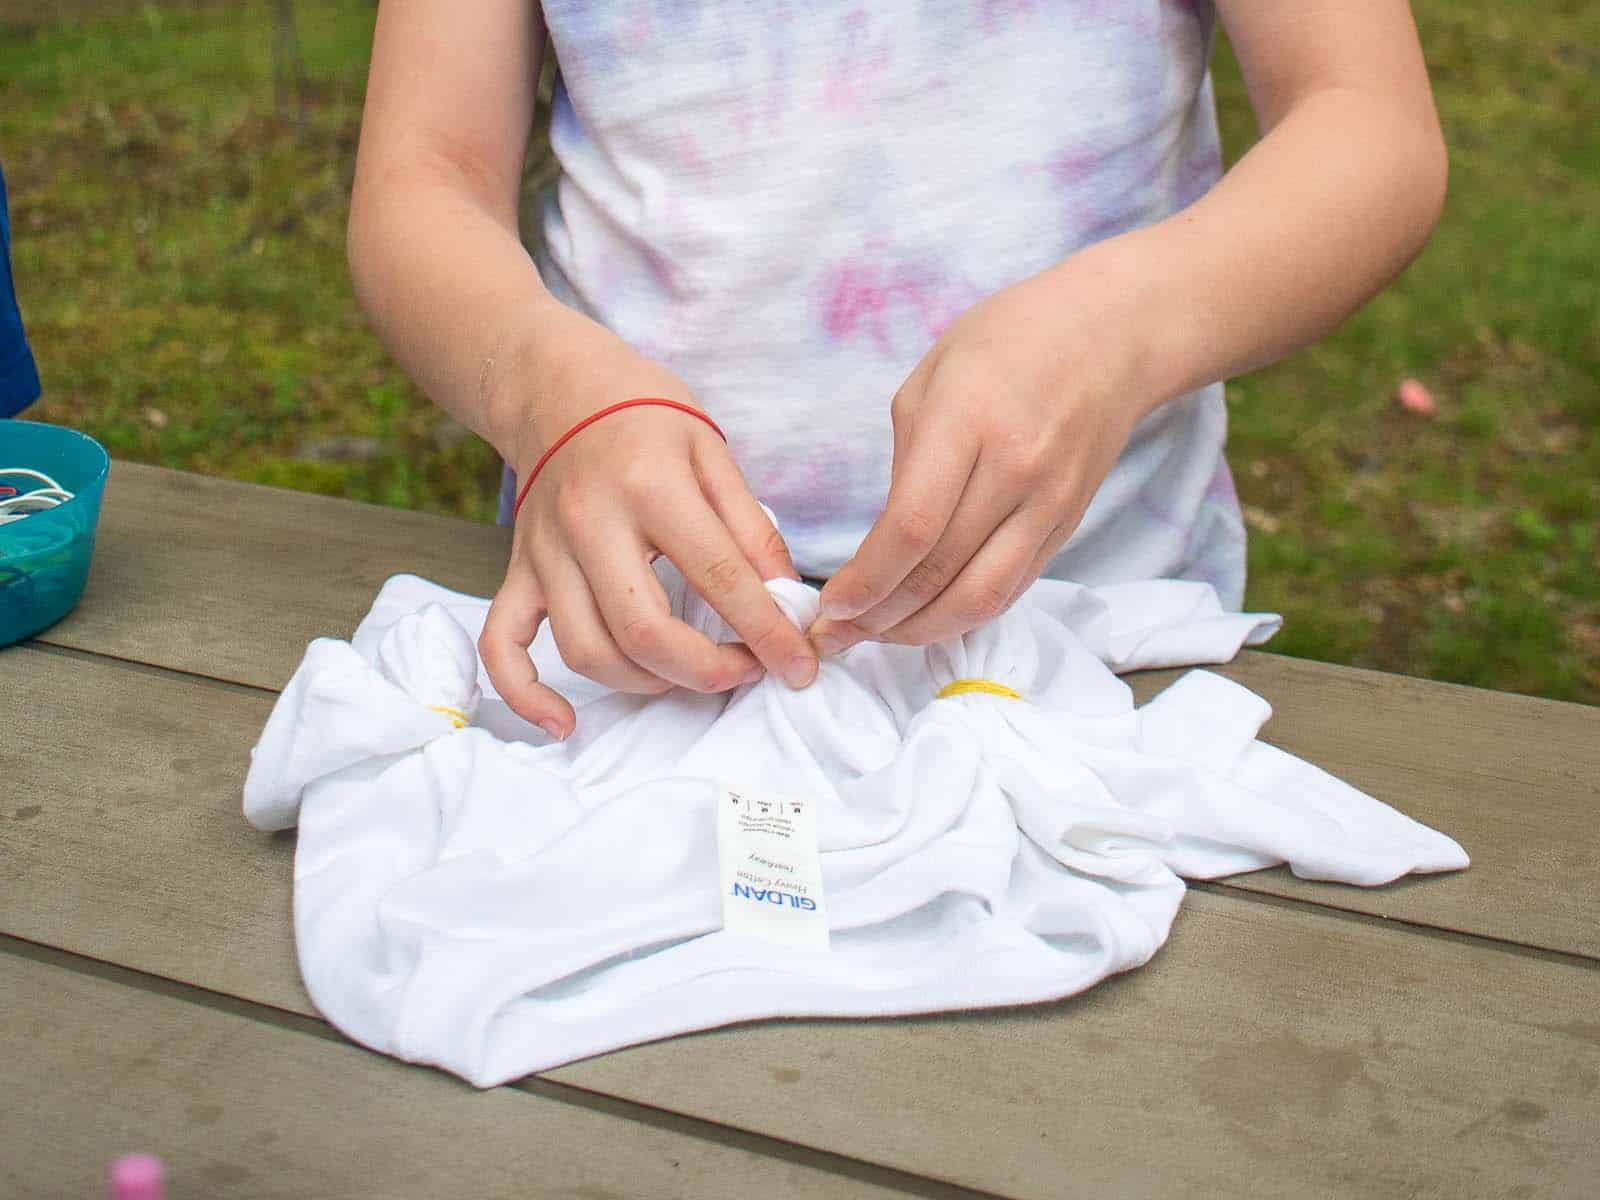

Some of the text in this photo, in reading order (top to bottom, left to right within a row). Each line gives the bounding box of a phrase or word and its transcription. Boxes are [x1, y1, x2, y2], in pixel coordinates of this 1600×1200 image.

[736, 871, 807, 894] Heavy Cotton
[734, 882, 817, 911] GILDAN
